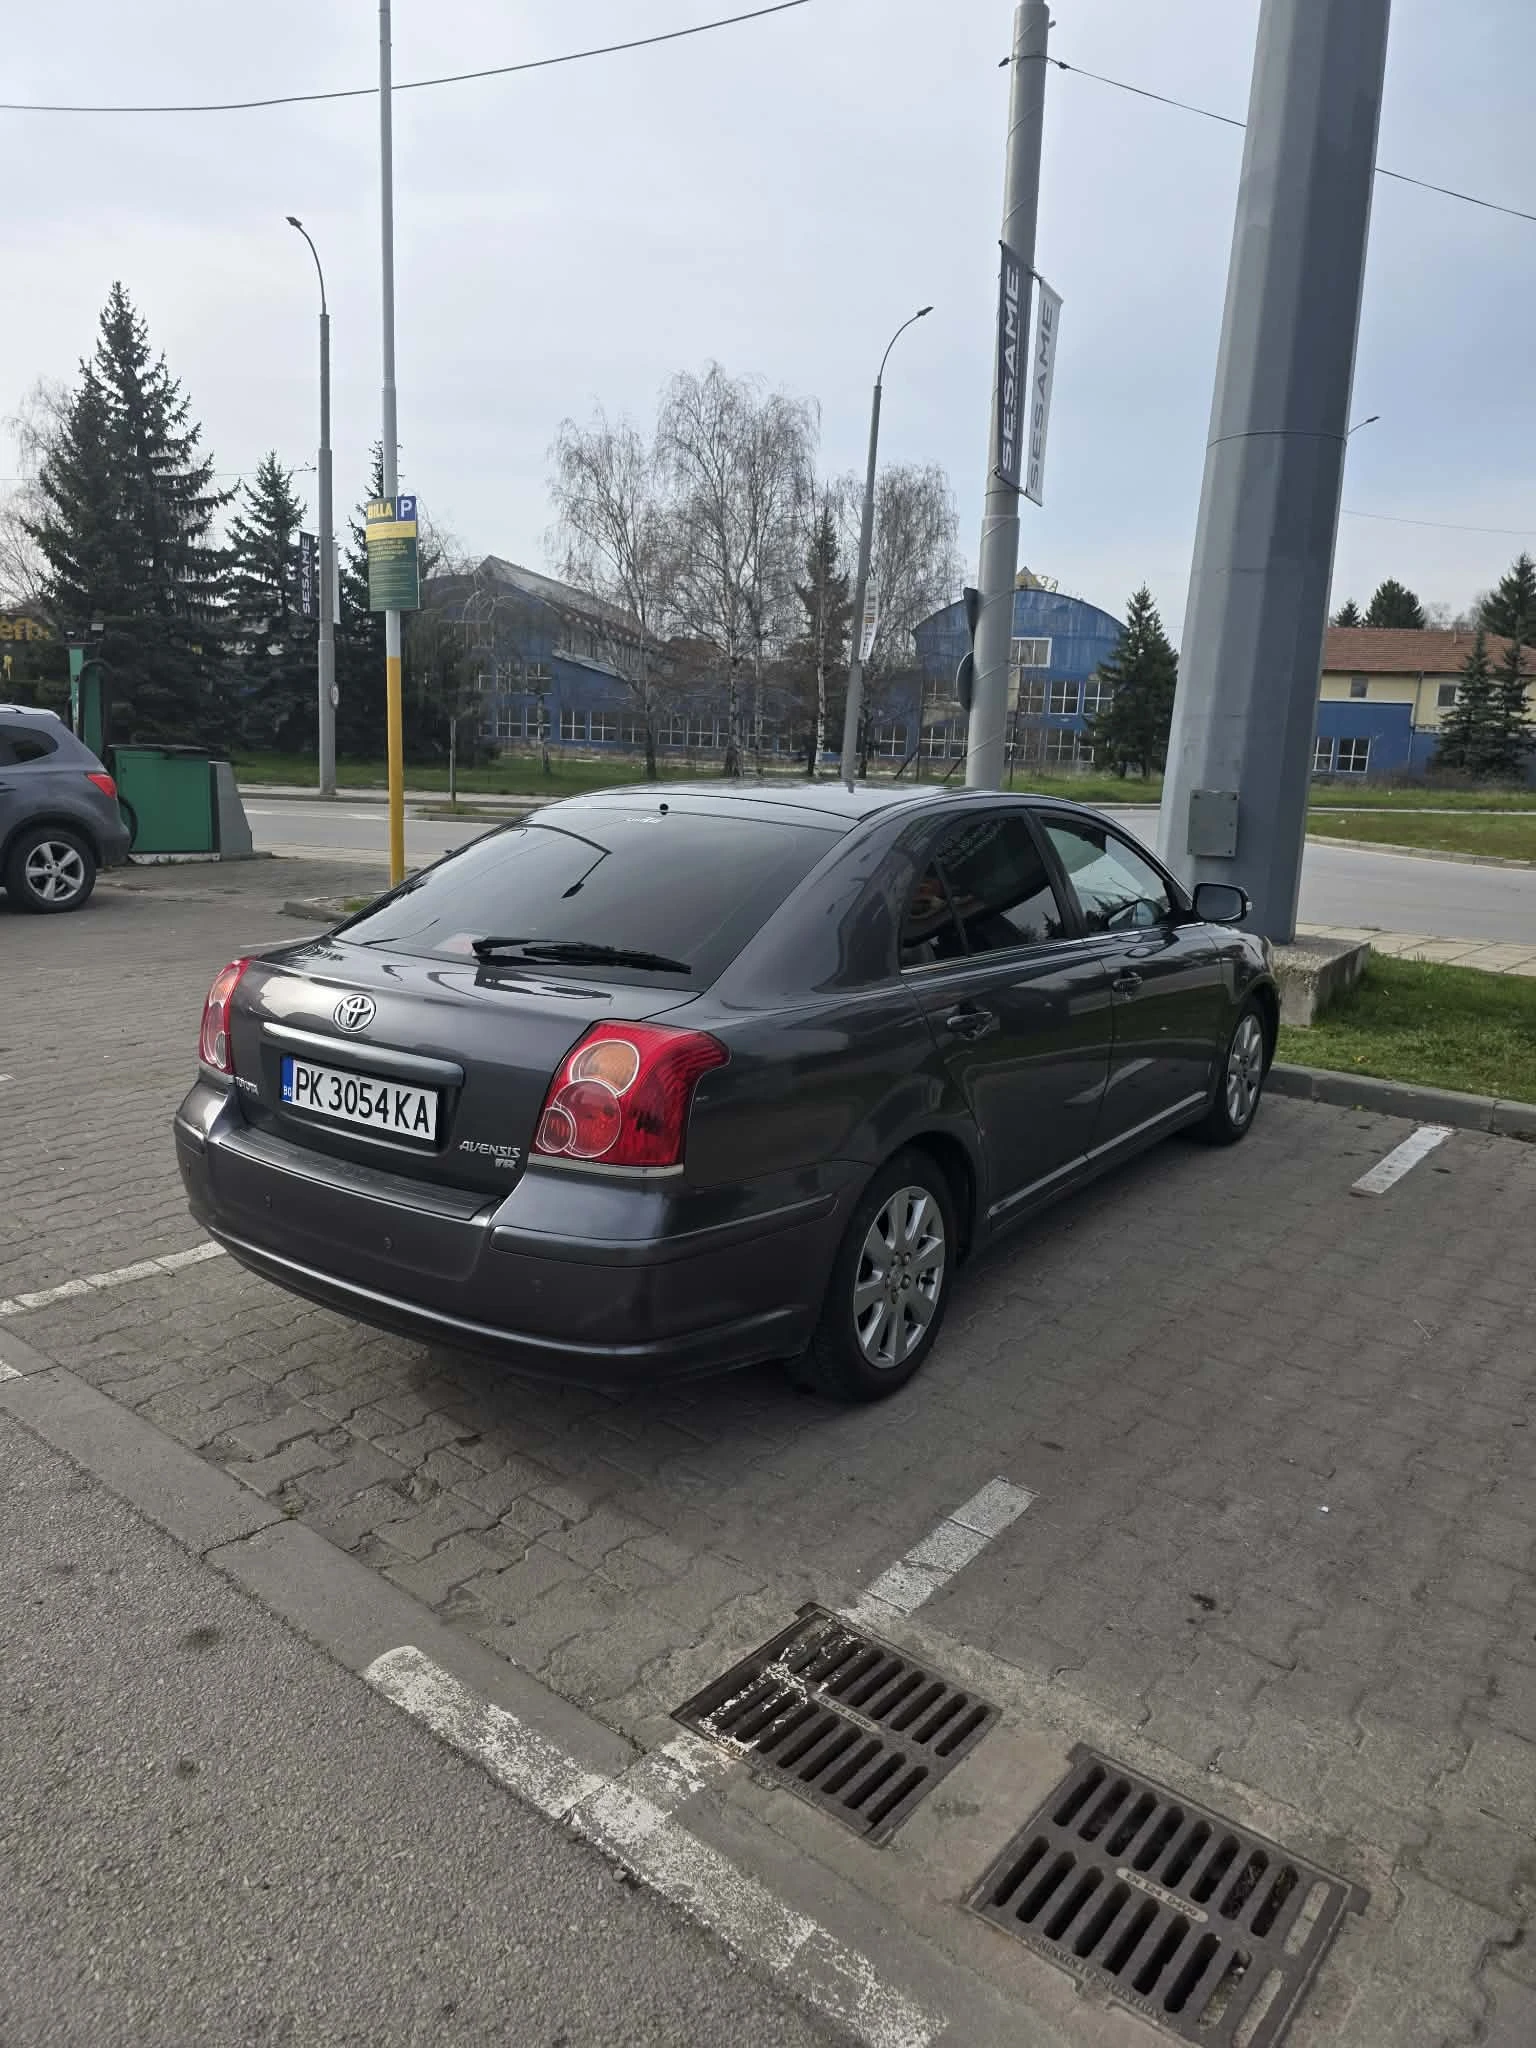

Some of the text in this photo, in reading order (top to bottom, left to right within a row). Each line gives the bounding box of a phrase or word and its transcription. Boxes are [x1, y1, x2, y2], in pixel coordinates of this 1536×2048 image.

[1002, 264, 1020, 473] SESAME
[1030, 306, 1053, 490] SESAME
[401, 500, 413, 518] P
[302, 536, 311, 615] SESAME
[283, 1086, 292, 1097] BG
[459, 1140, 521, 1158] AVENSIS
